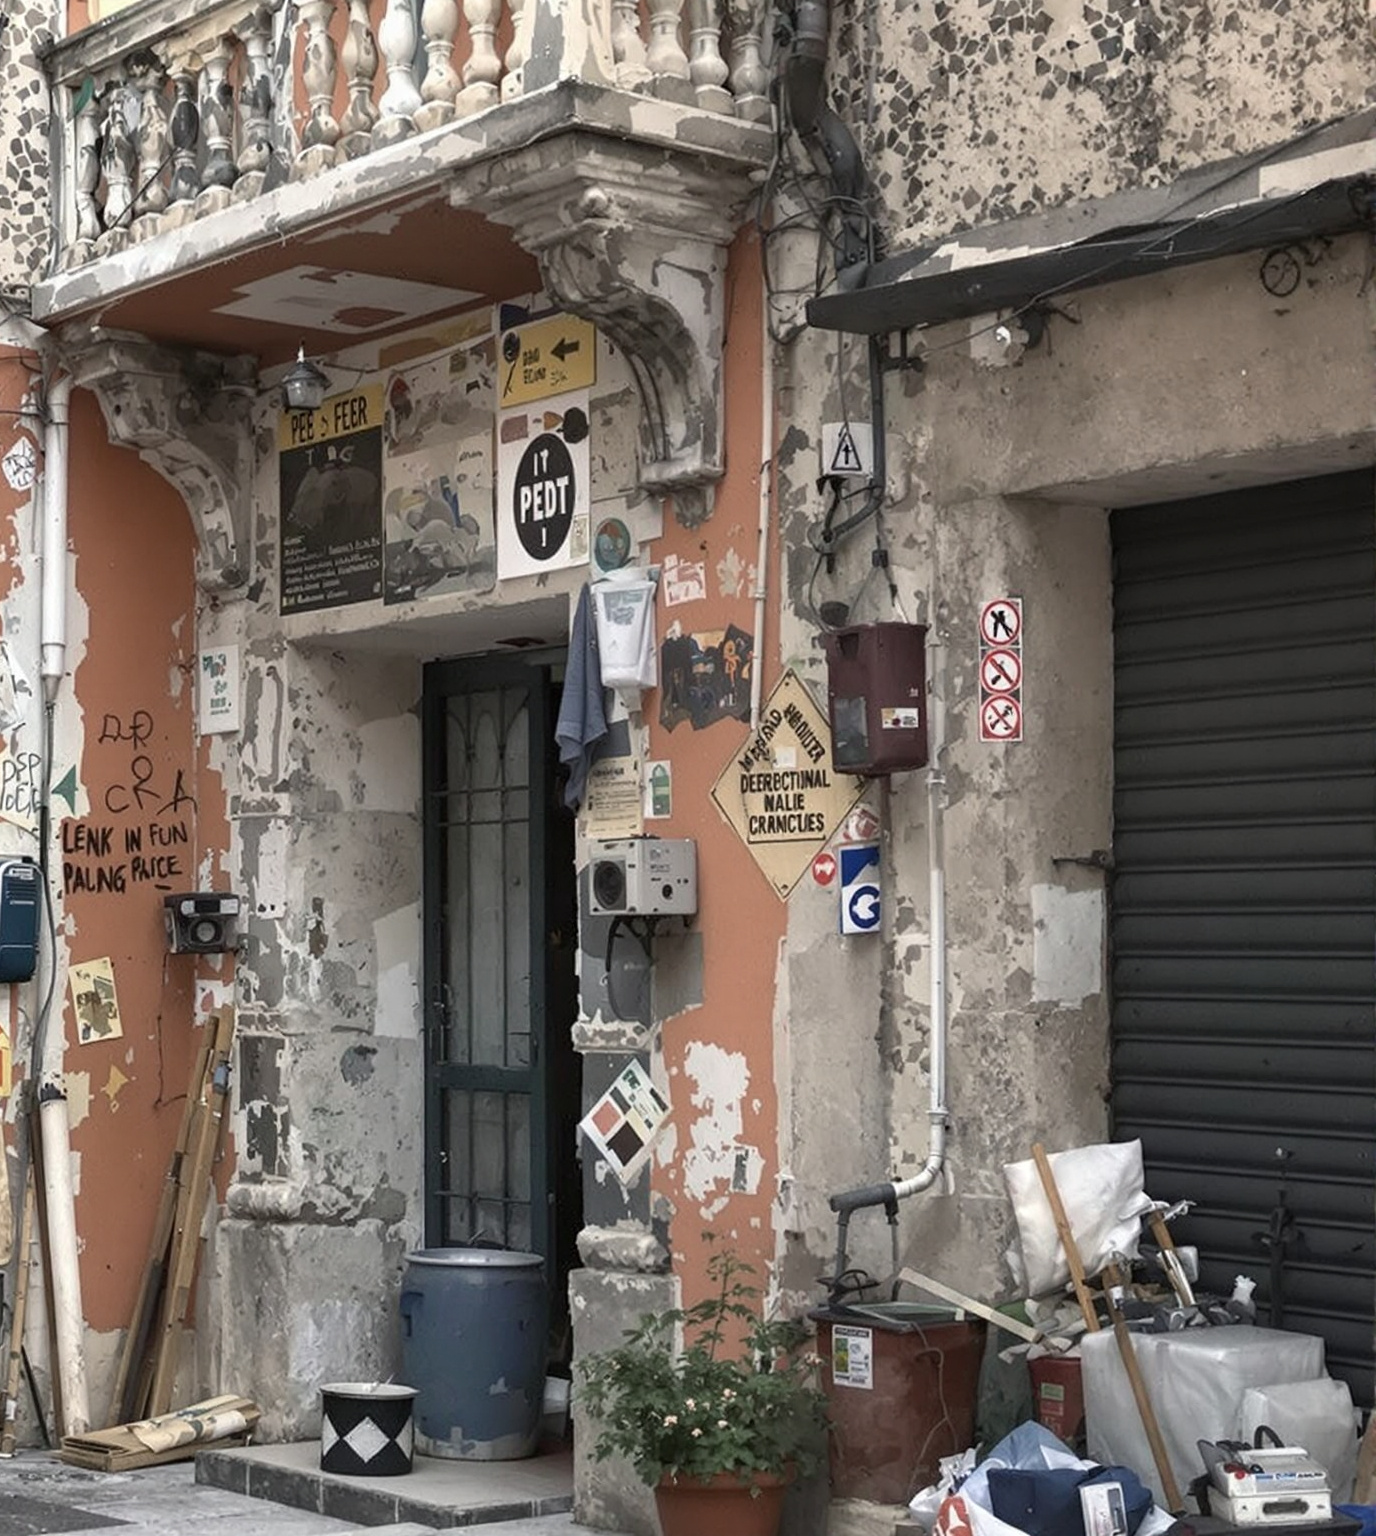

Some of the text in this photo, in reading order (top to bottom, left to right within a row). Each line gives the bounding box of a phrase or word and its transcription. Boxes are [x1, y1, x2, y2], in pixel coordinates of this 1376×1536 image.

[520, 475, 570, 524] PEDT
[125, 826, 142, 854] IN
[149, 820, 188, 847] FUN
